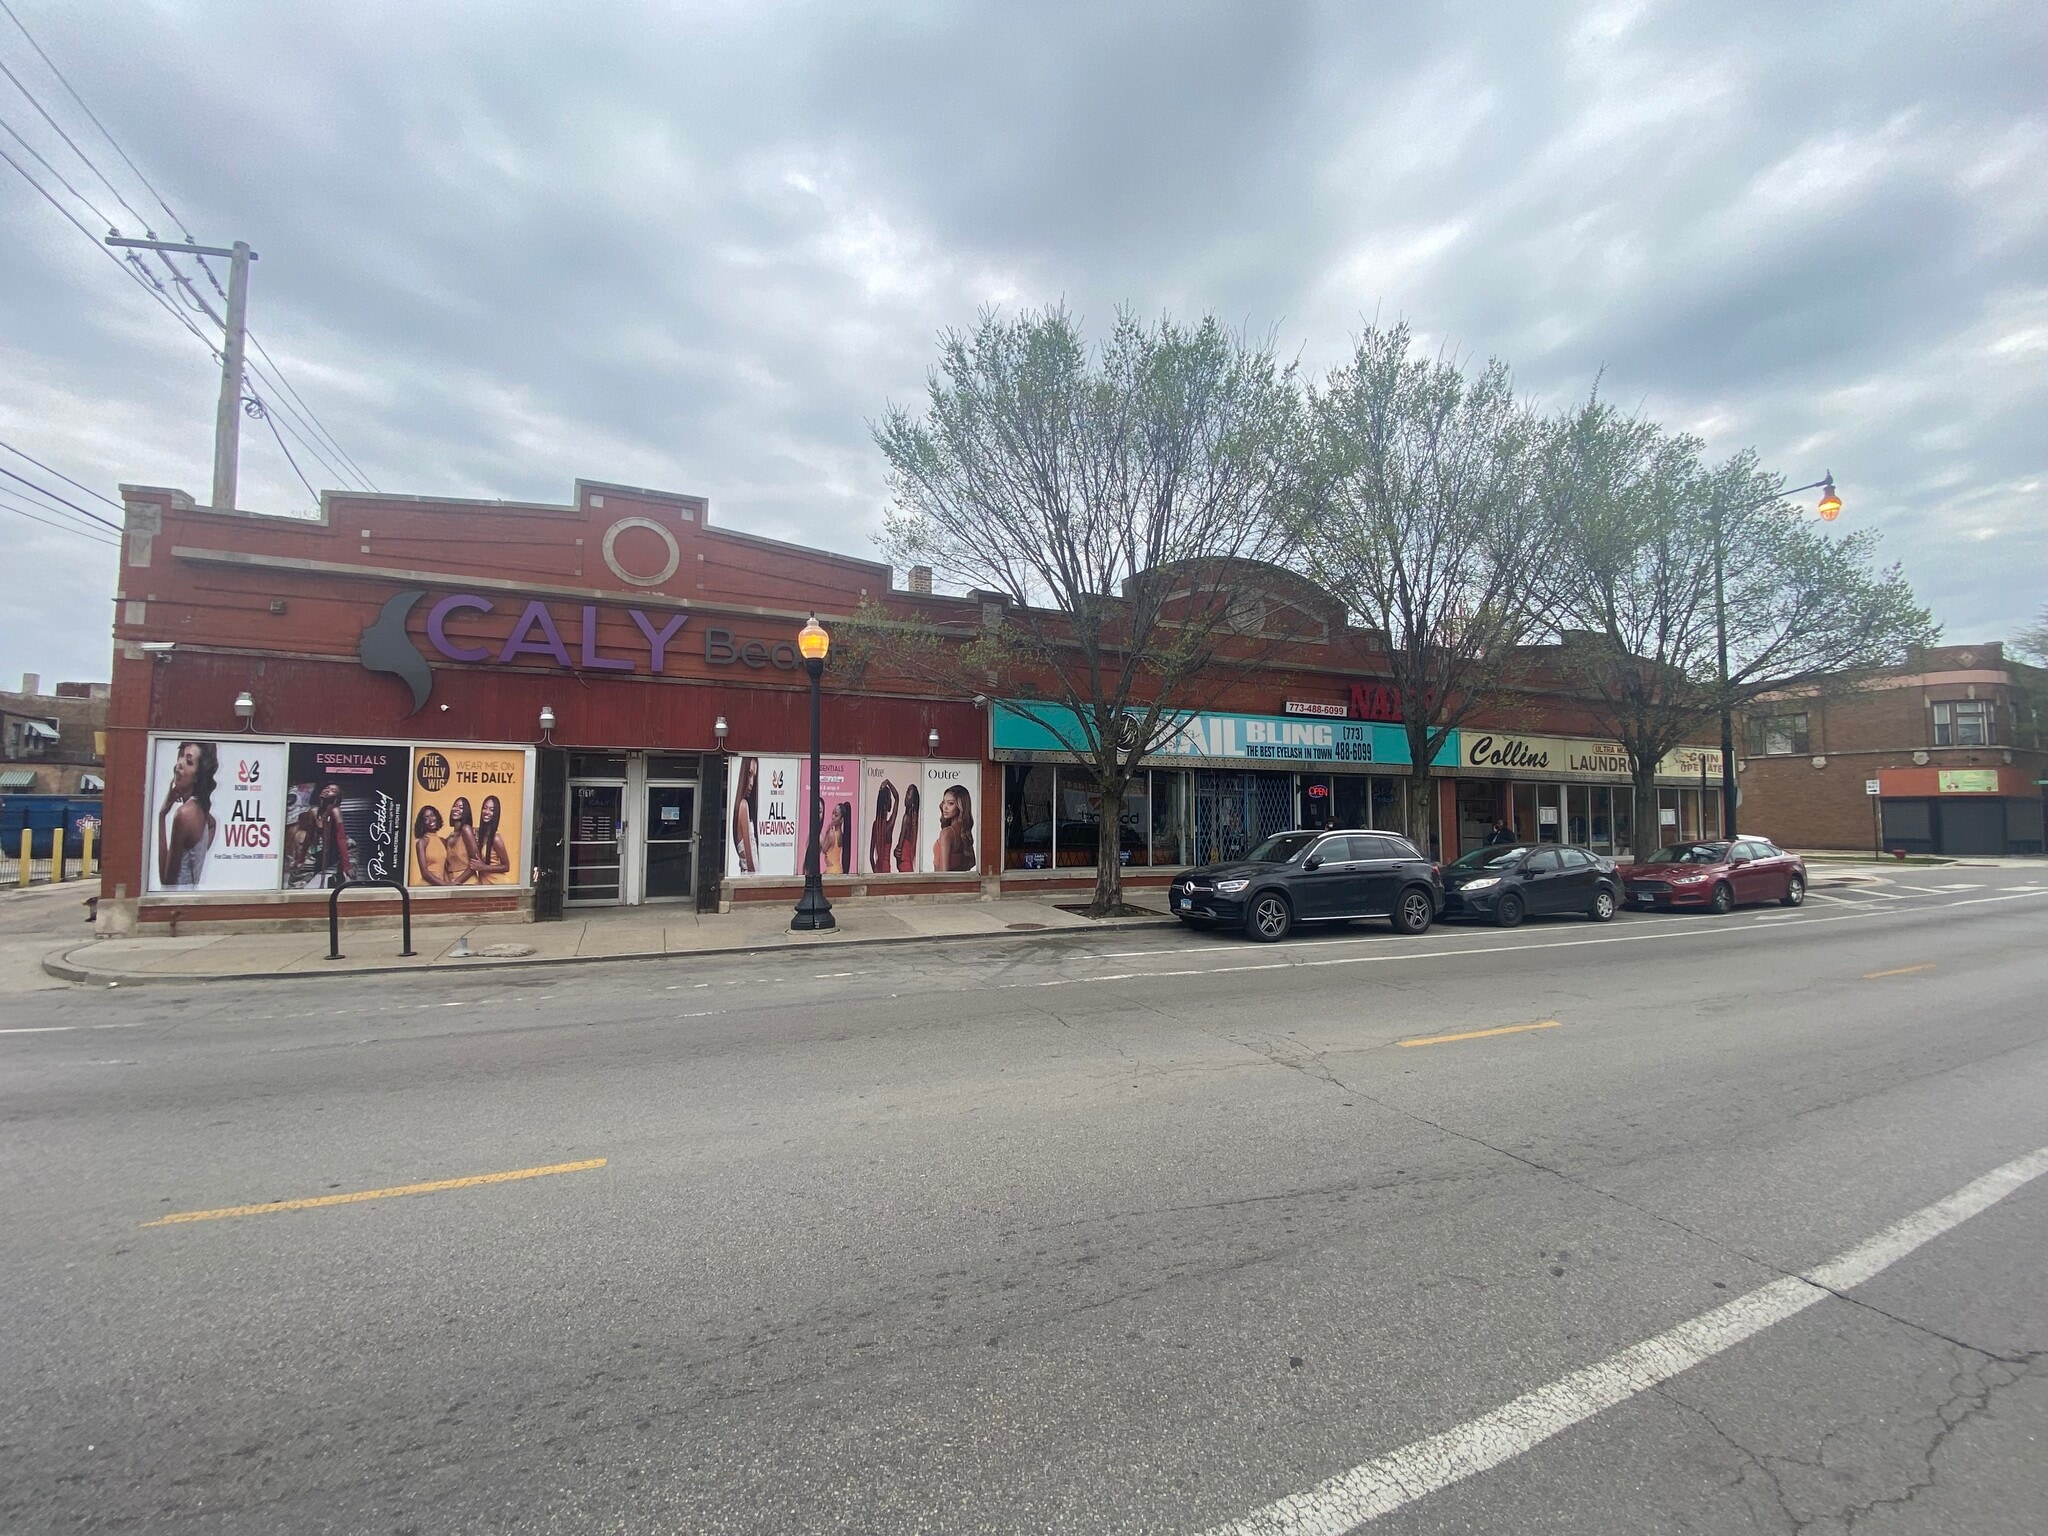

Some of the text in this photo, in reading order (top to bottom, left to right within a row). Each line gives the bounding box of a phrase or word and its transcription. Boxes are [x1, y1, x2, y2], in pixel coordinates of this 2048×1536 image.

[427, 594, 689, 673] CALY
[1289, 703, 1344, 716] 773-488-6099
[1246, 721, 1333, 746] BLING
[1343, 726, 1363, 741] (773)
[1246, 745, 1333, 760] THE BEST EYELASH IN TOWN
[1335, 742, 1372, 761] 488-6099
[1469, 736, 1550, 768] Collins
[316, 753, 387, 765] ESSENTIALS
[424, 756, 440, 766] THE
[456, 761, 515, 771] WEAR ME ON
[422, 767, 446, 778] DAILY
[456, 772, 516, 784] THE DAILY.
[928, 769, 960, 780] Outre
[428, 778, 446, 790] WIG
[1309, 786, 1328, 797] OPEN
[231, 799, 266, 822] ALL
[768, 802, 786, 820] ALL
[759, 821, 794, 835] WEAVINGS
[224, 823, 271, 848] WIGS
